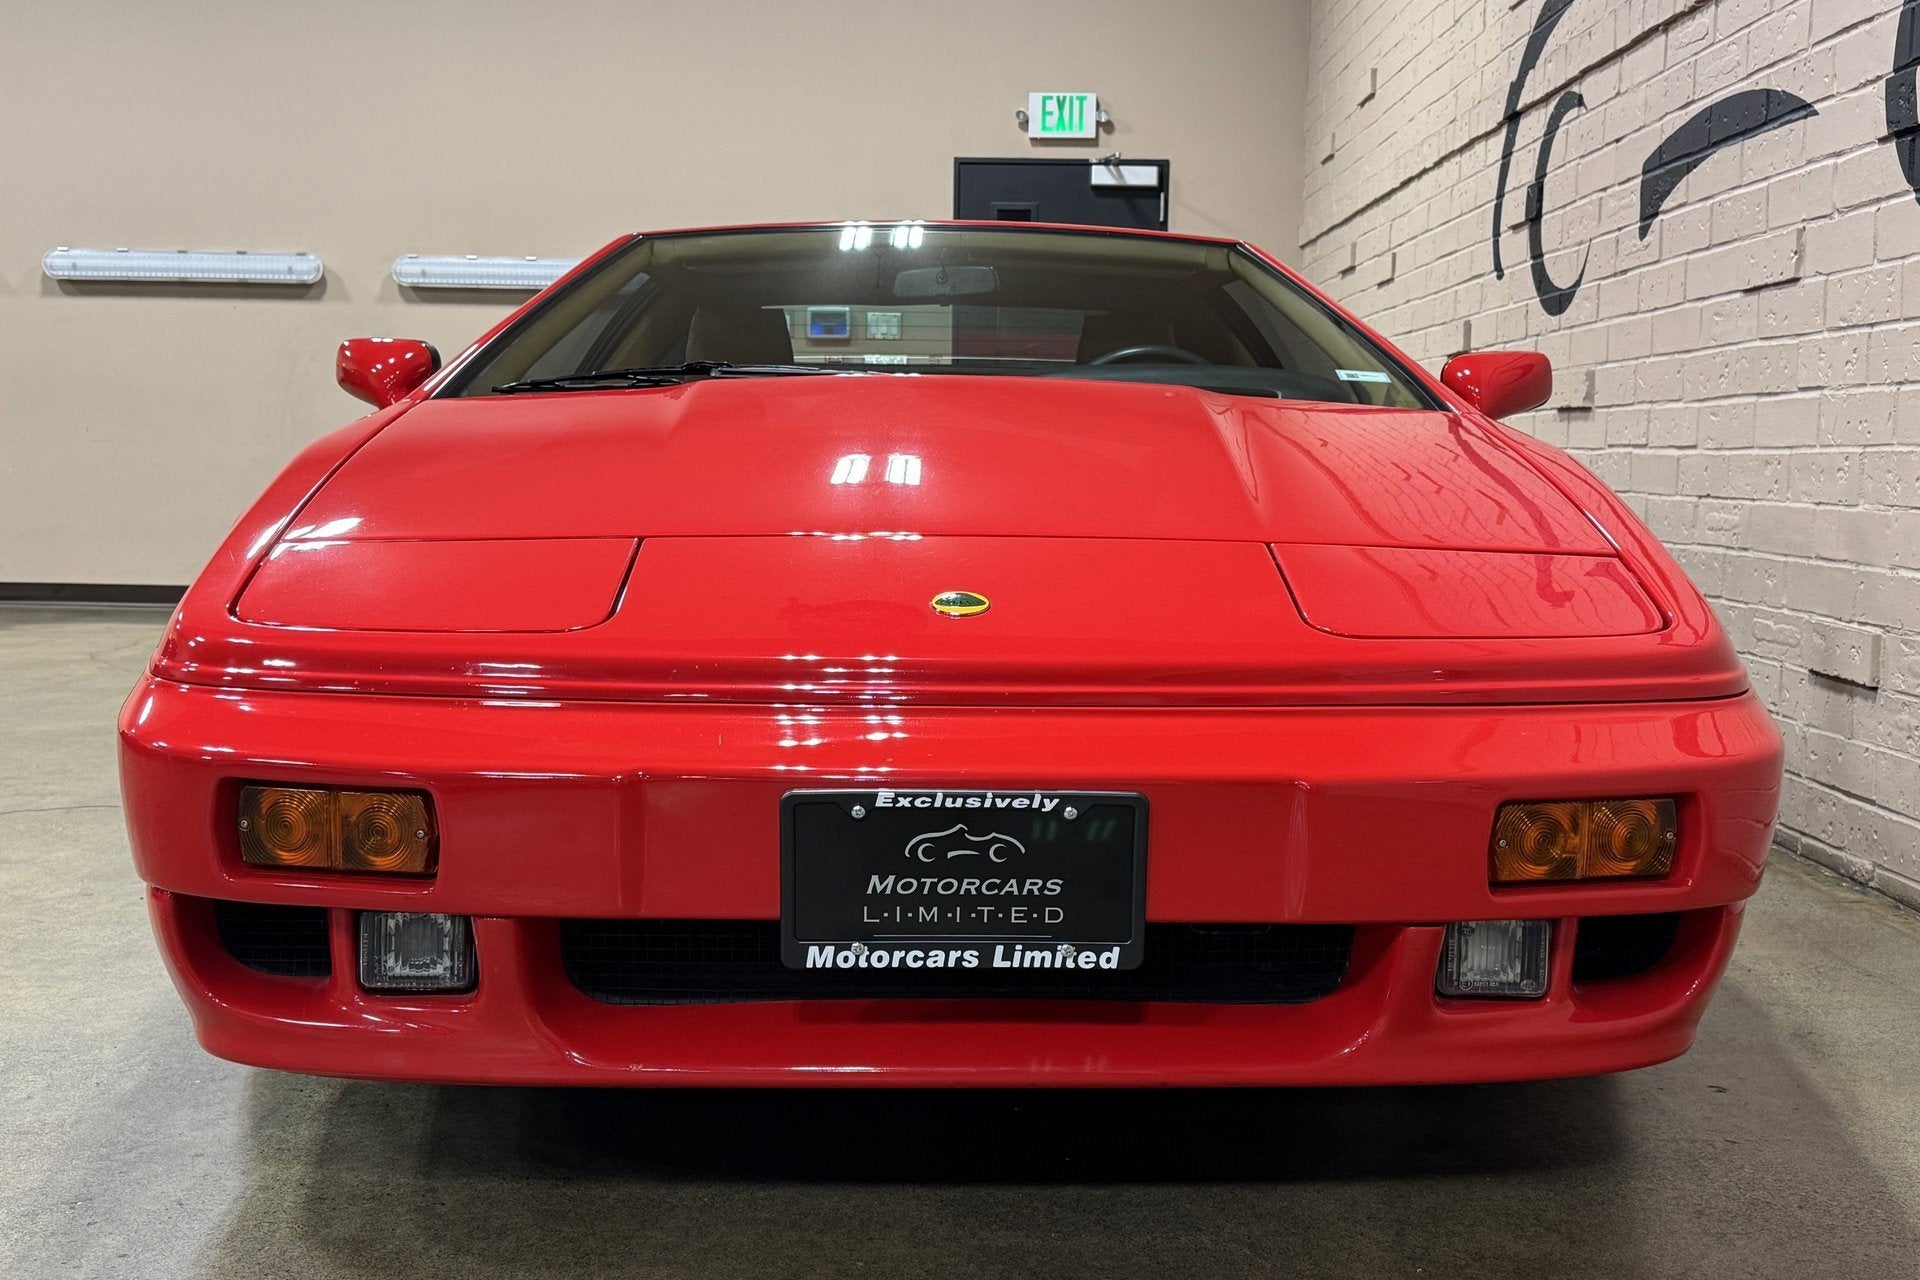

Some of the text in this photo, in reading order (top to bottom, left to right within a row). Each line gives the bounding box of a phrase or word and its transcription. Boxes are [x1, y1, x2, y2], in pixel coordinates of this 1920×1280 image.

[1041, 95, 1087, 132] EXIT
[875, 791, 1060, 812] Exclusively
[866, 874, 1064, 896] MOTORCARS
[805, 944, 1121, 970] Motorcars Limited
